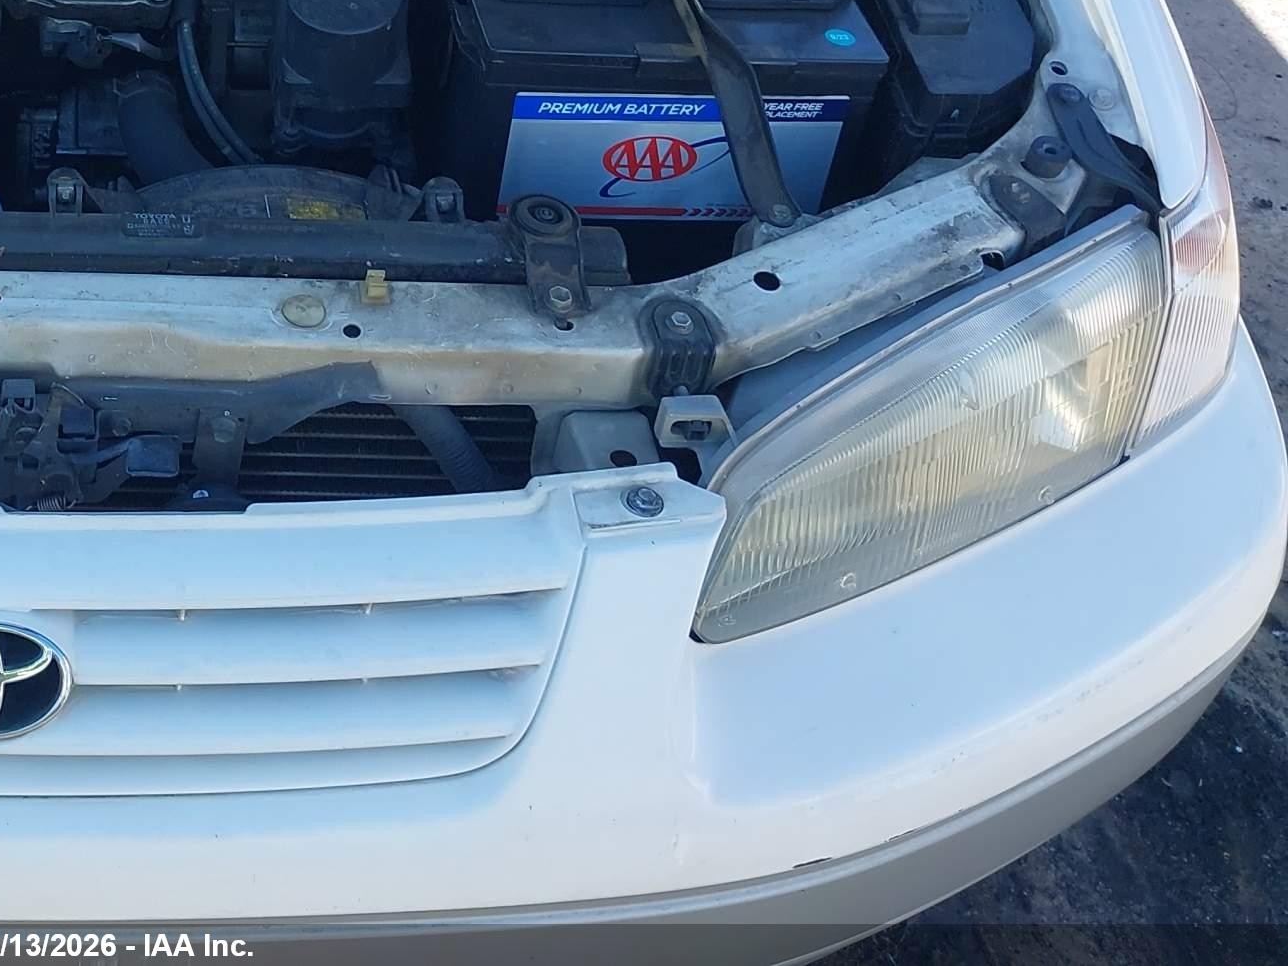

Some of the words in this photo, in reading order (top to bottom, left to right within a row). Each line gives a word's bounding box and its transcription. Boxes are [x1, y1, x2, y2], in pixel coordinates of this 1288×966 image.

[537, 101, 622, 115] PREMIUM
[623, 103, 706, 117] BATTERY
[764, 102, 793, 111] YEAR
[793, 102, 825, 111] FREE
[610, 137, 689, 181] AAA
[133, 212, 177, 220] TOYOTA
